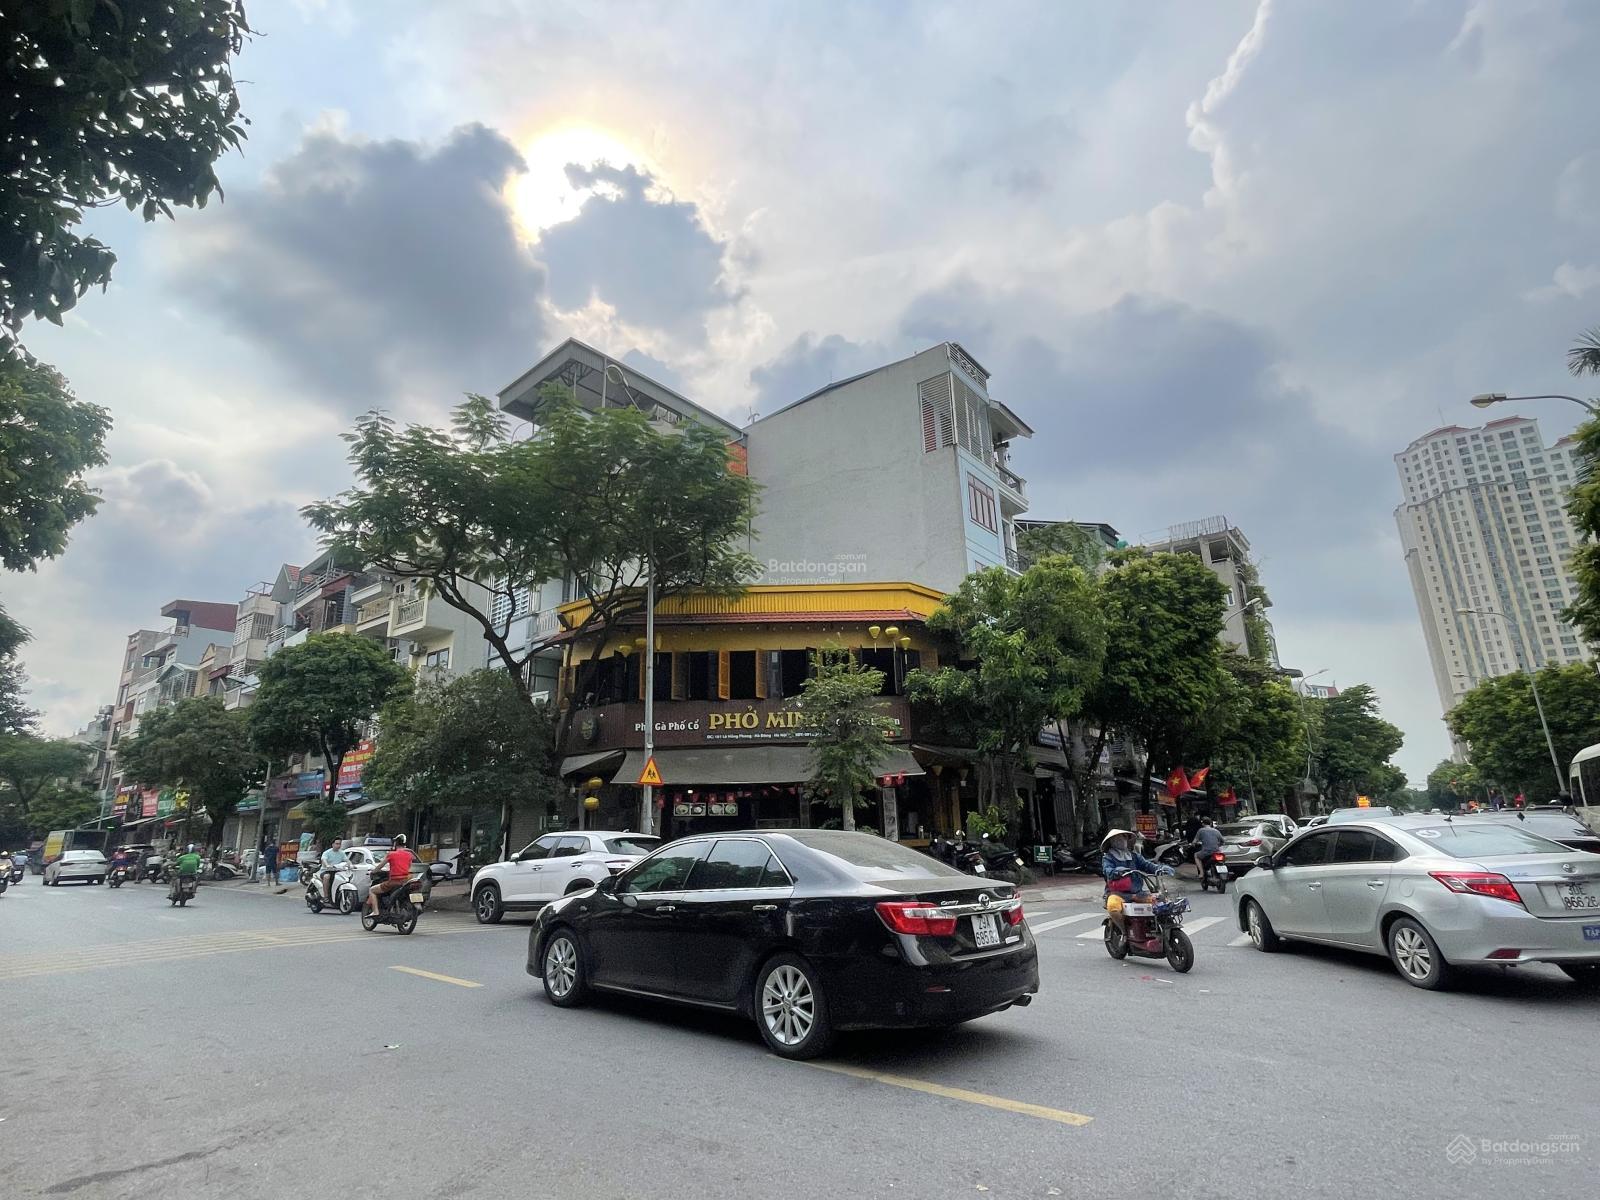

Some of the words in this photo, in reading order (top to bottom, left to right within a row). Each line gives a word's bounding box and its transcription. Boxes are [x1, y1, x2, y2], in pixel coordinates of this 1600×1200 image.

[655, 721, 667, 731] Gà
[668, 719, 686, 731] Phố
[709, 705, 759, 730] PHỞ
